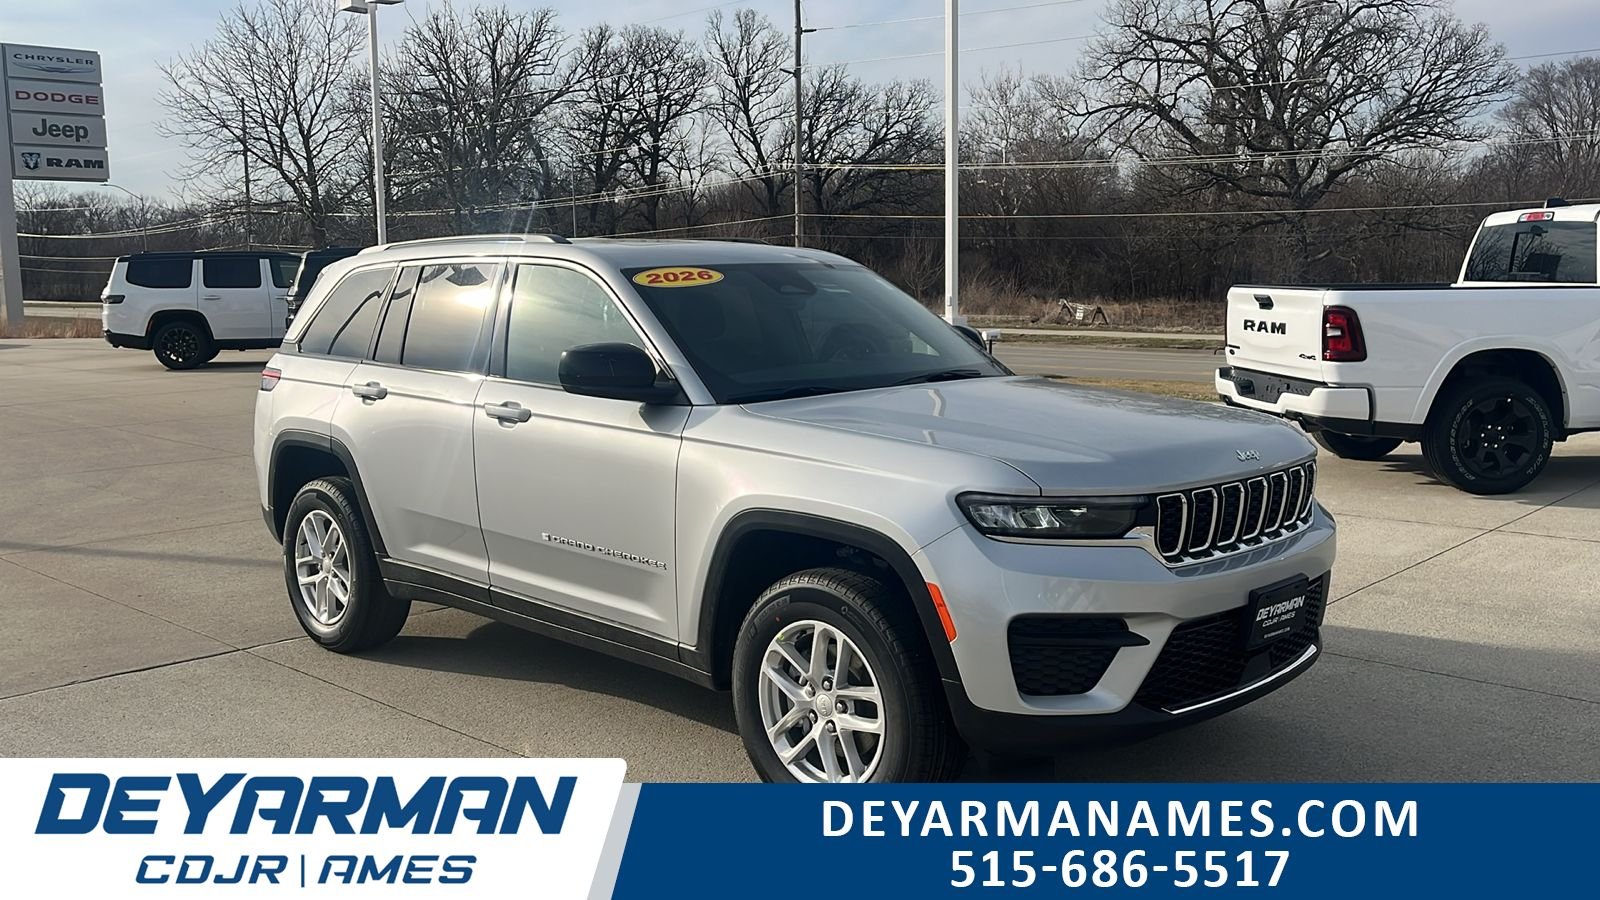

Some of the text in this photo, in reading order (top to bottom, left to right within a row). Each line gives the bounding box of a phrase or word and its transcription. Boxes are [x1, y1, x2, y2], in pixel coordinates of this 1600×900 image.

[13, 53, 94, 65] CHRYSLER
[15, 90, 99, 105] DODGE
[32, 118, 88, 142] Jeep
[46, 157, 104, 169] RAM
[646, 270, 713, 284] 2026
[1243, 319, 1286, 335] RAM
[552, 535, 667, 569] GRAND CHEROKEE
[1256, 595, 1305, 621] DEYARMAN
